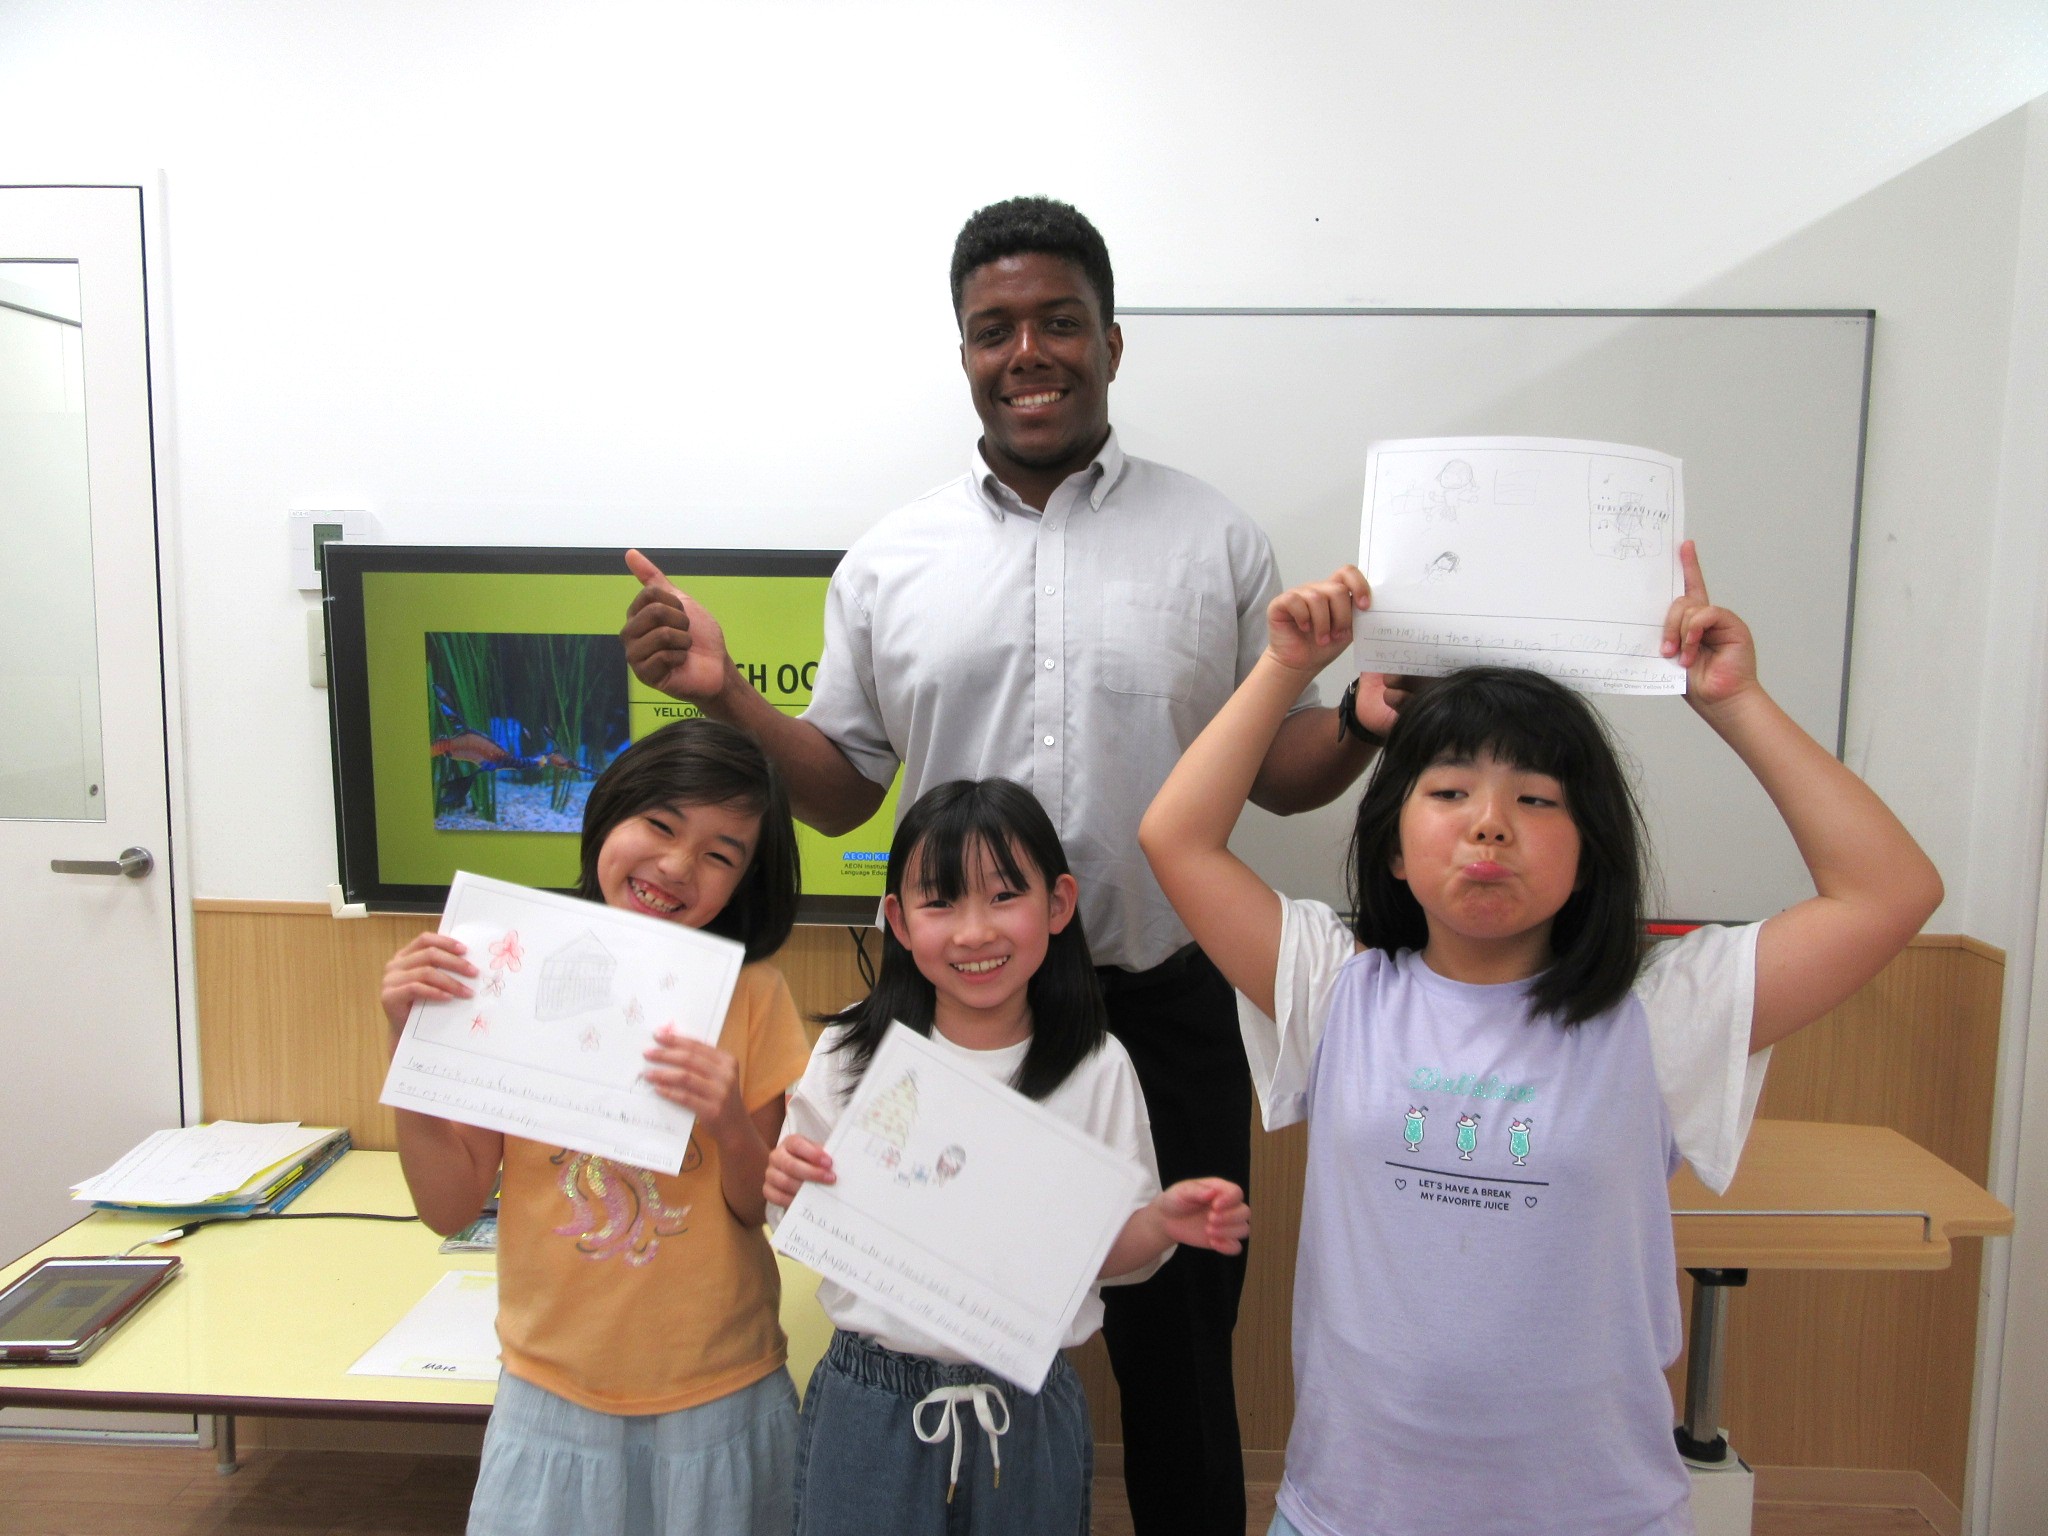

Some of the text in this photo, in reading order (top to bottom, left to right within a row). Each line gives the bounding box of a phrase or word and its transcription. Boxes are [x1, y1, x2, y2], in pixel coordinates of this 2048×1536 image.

[735, 663, 767, 693] H
[843, 852, 873, 861] AEON
[1419, 1179, 1512, 1199] LET'S HAVE A BREAK
[1420, 1191, 1510, 1211] MY FAVORITE JUICE
